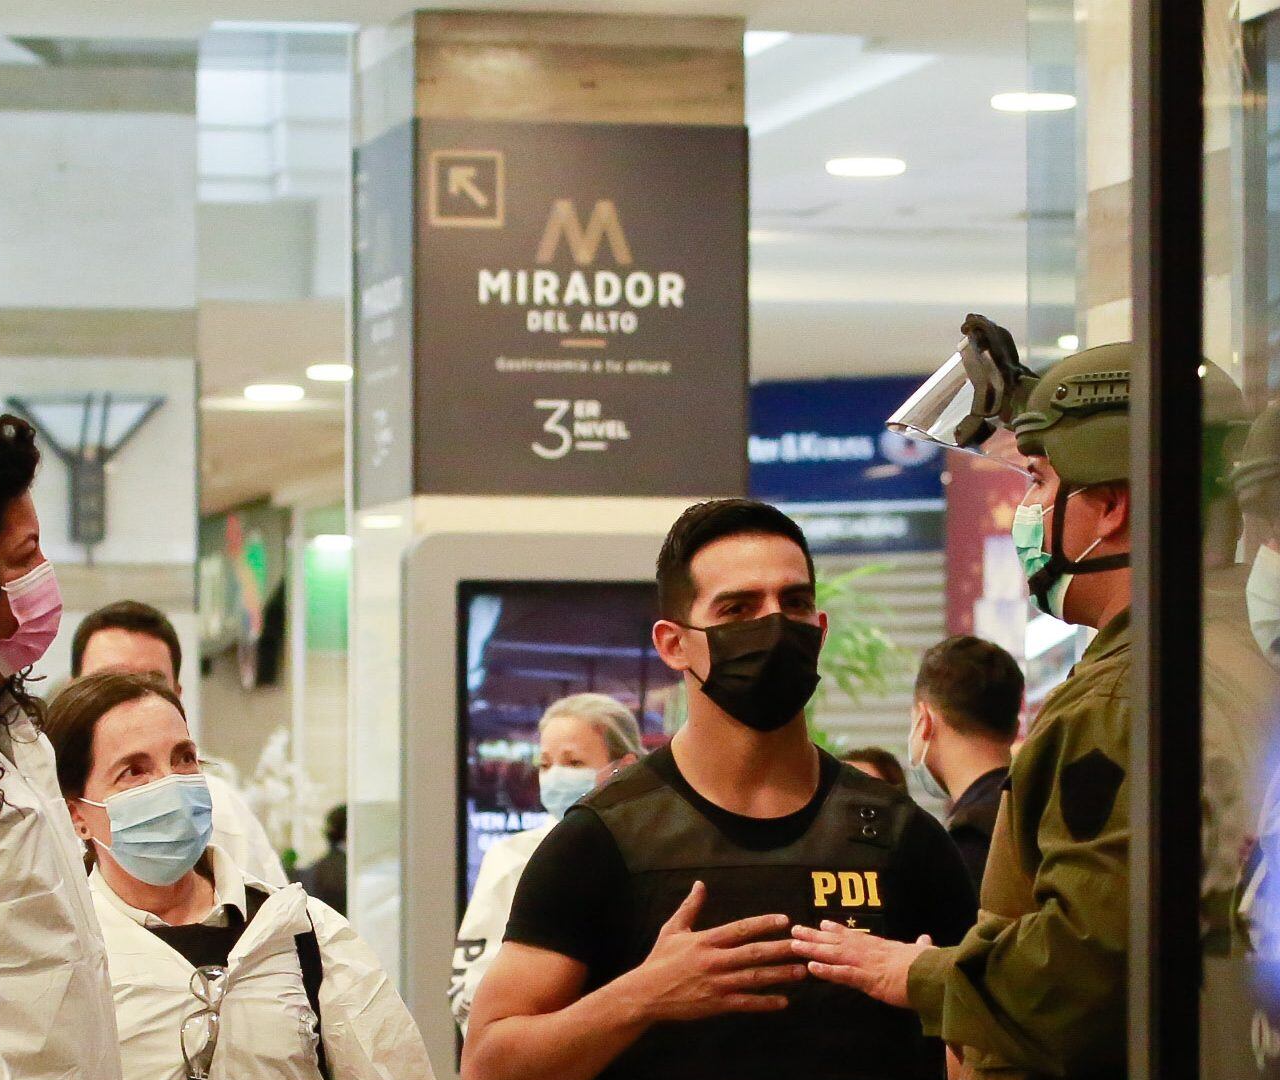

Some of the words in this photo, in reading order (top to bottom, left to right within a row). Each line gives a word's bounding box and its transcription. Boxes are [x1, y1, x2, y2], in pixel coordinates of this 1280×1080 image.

[477, 267, 686, 308] MIRADOR
[525, 309, 571, 334] DEL
[579, 311, 639, 335] ALTO
[531, 398, 572, 460] 3
[573, 419, 631, 441] NIVEL
[811, 871, 881, 907] PDI
